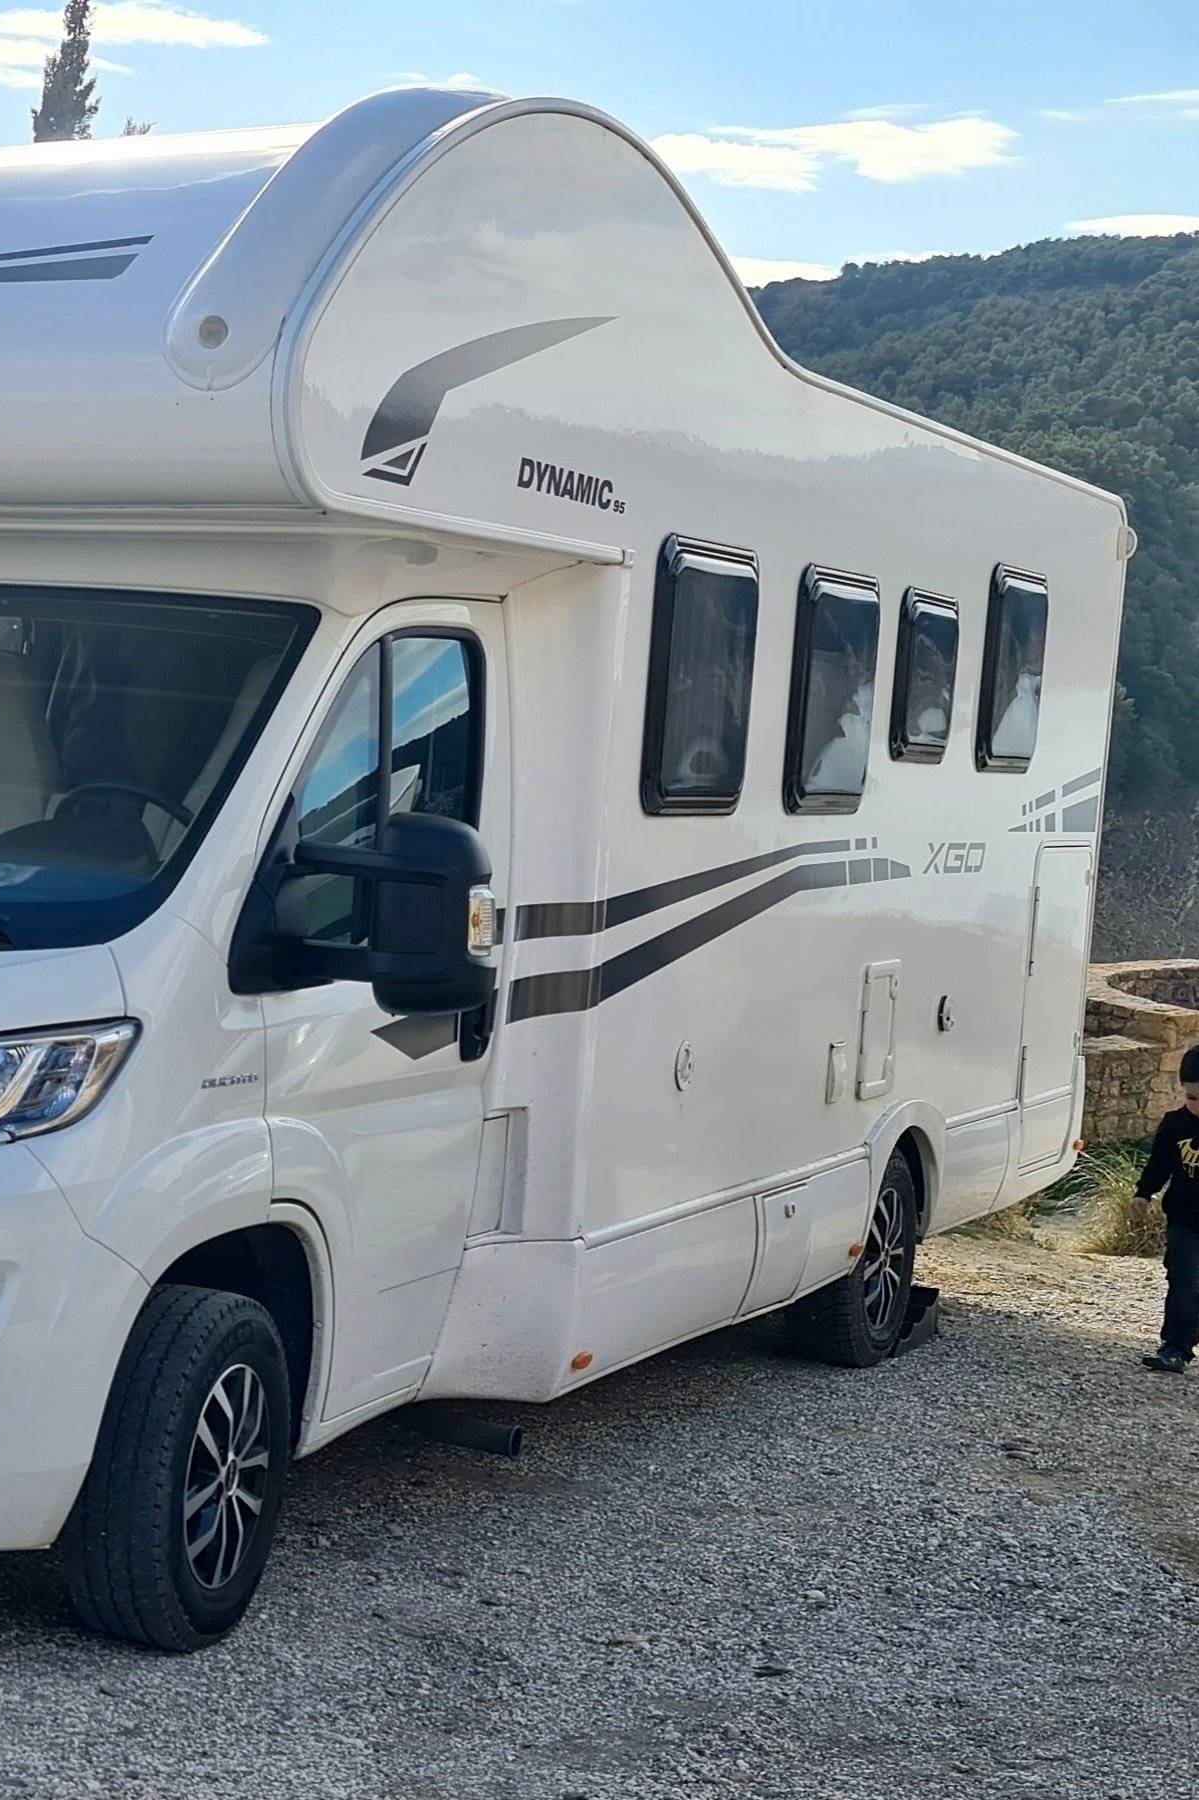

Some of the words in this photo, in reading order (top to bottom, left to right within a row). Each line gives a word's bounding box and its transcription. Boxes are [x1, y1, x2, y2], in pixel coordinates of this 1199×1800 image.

[516, 456, 613, 510] DYNAMIC
[613, 500, 626, 514] 95
[922, 842, 987, 875] XGO
